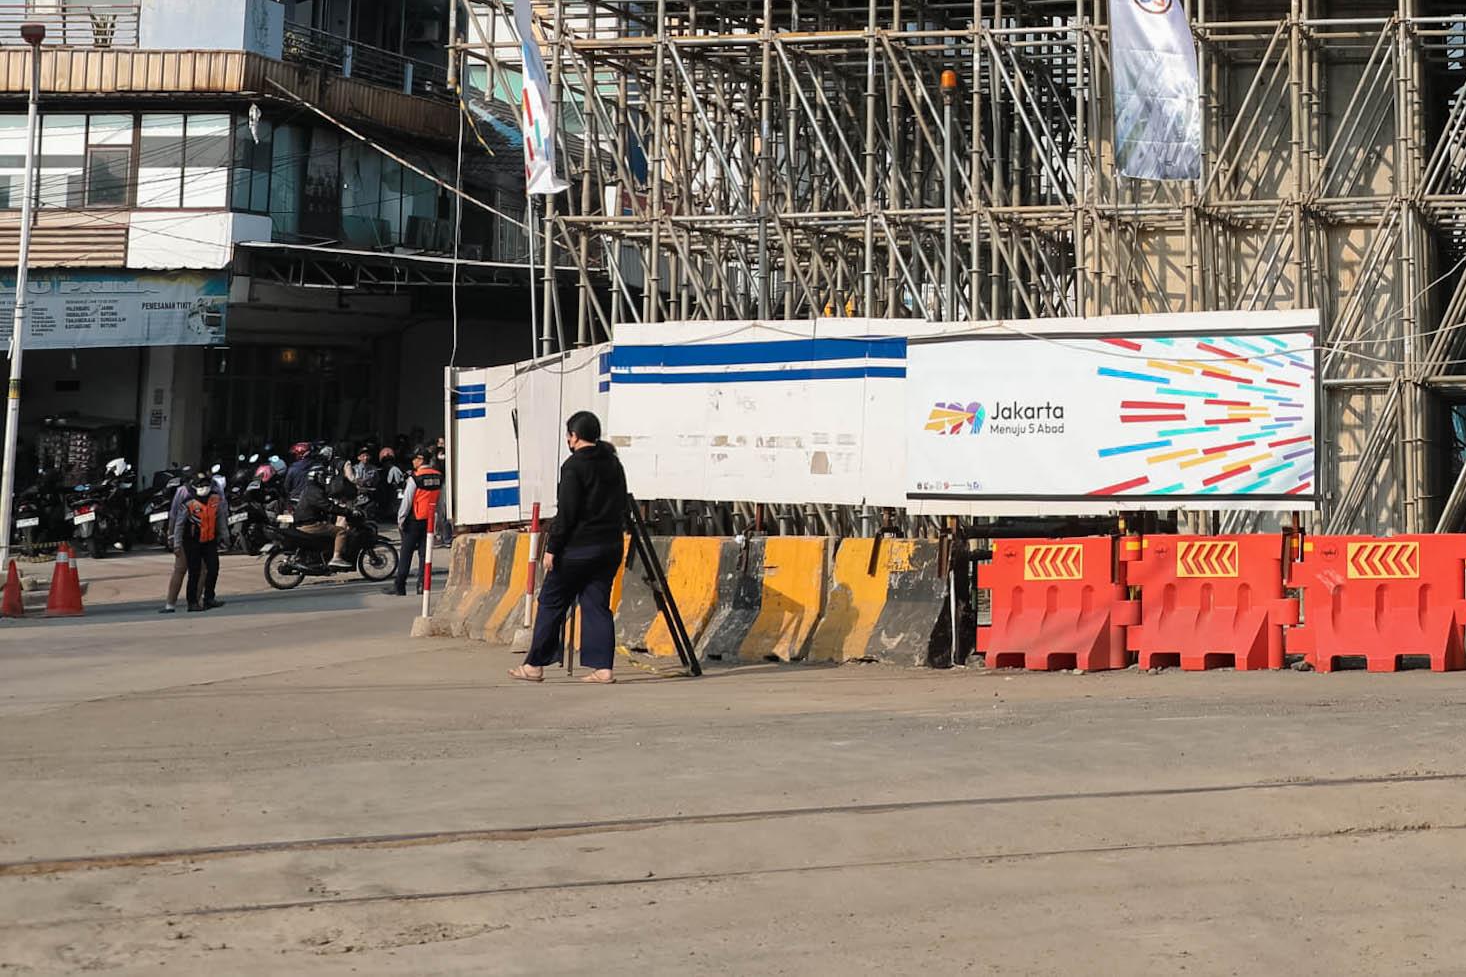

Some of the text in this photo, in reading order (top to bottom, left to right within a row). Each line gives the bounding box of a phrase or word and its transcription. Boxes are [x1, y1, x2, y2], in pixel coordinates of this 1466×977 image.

[991, 401, 1064, 420] Jakarta
[990, 424, 1026, 437] Menuju
[1037, 422, 1065, 434] Abad
